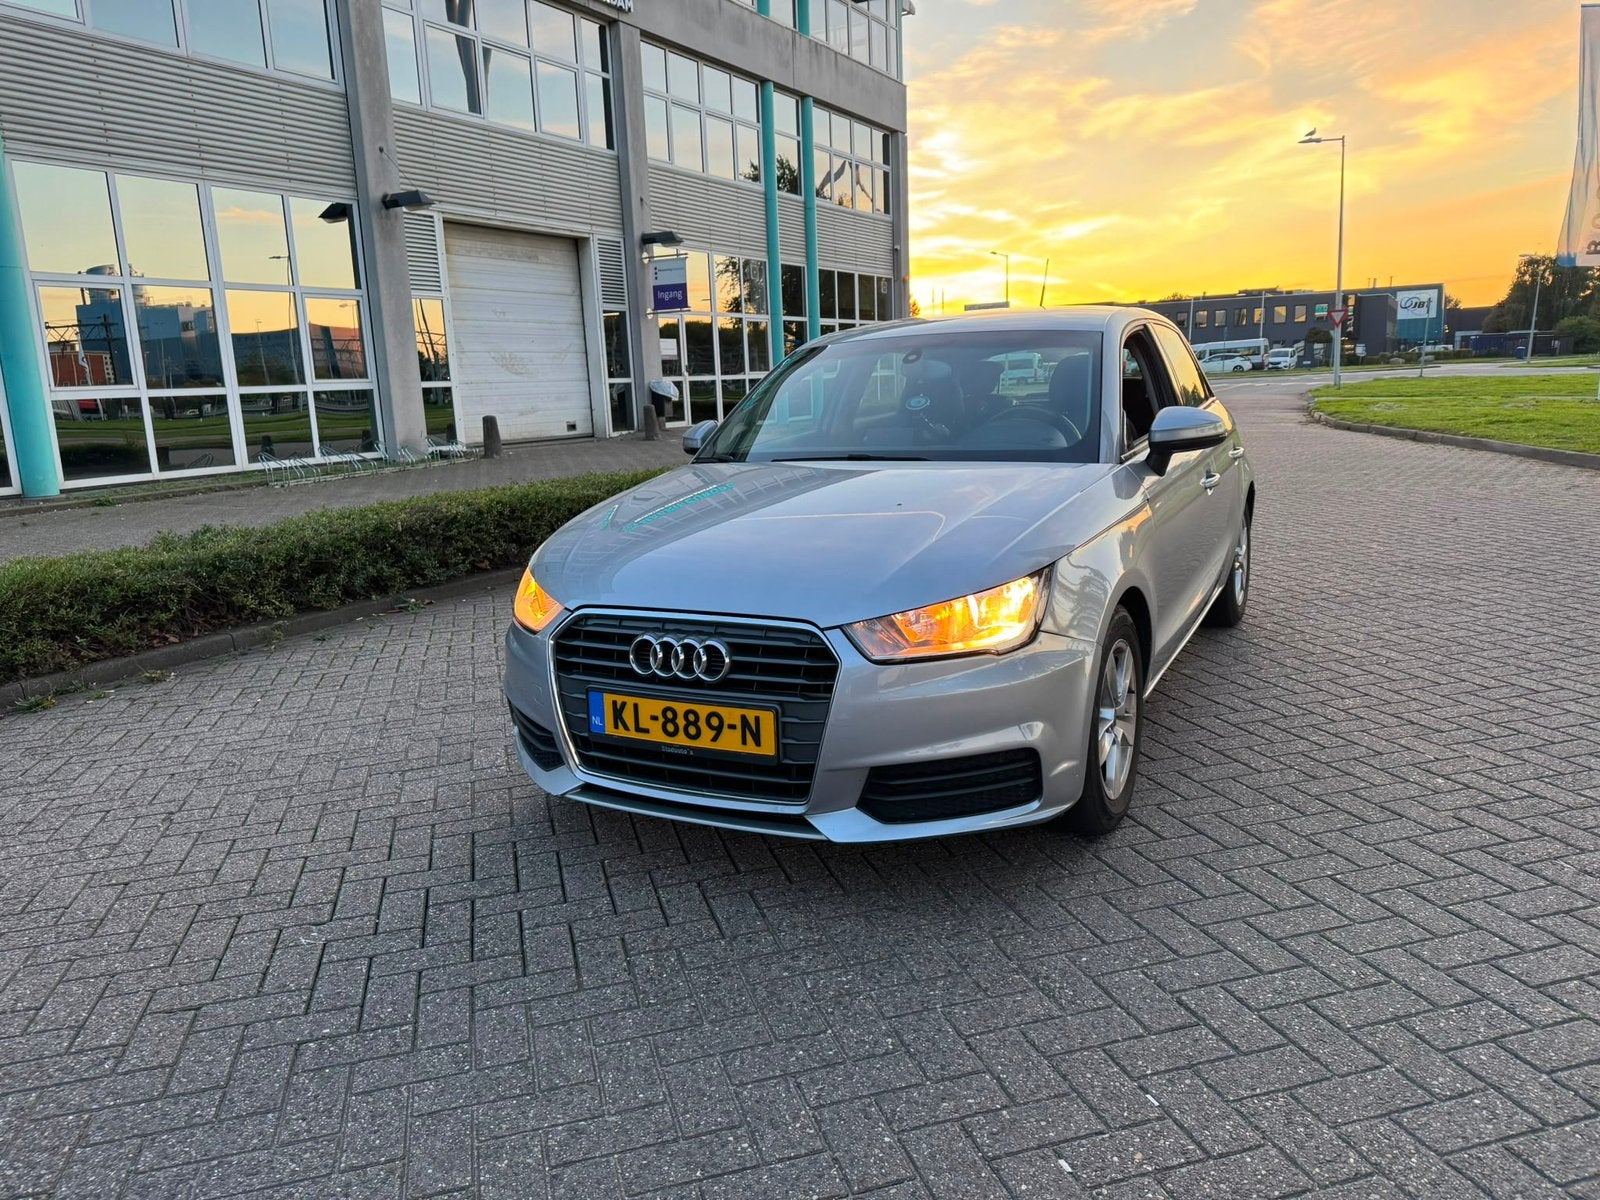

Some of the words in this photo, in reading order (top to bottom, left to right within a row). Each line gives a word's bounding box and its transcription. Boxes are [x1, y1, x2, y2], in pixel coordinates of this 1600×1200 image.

[657, 290, 683, 300] Ingang
[592, 716, 603, 726] NL
[611, 699, 762, 747] KL-889-N
